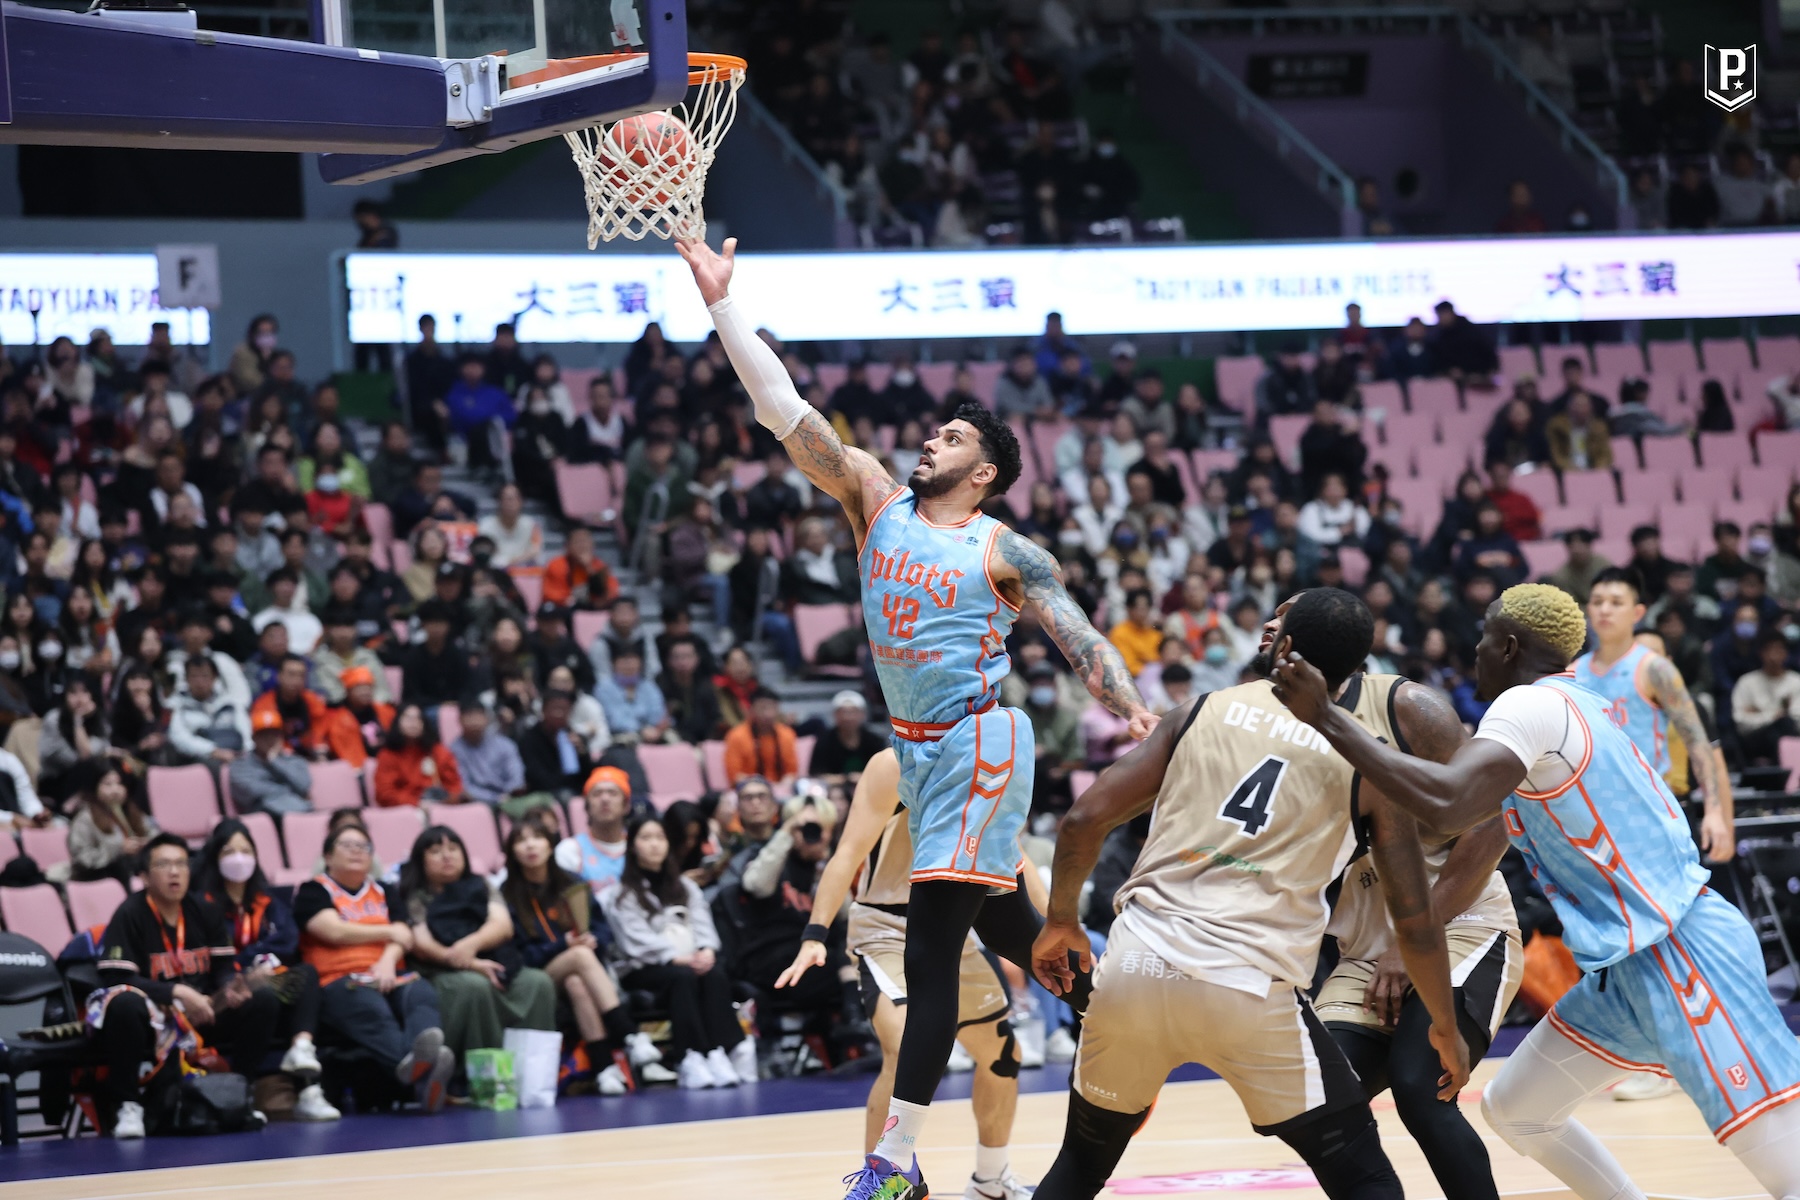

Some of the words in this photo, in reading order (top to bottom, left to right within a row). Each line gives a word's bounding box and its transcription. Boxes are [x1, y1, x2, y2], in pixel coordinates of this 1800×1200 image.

[178, 256, 196, 290] F
[882, 593, 920, 640] 42
[1216, 754, 1290, 840] 4
[0, 951, 47, 968] sonic
